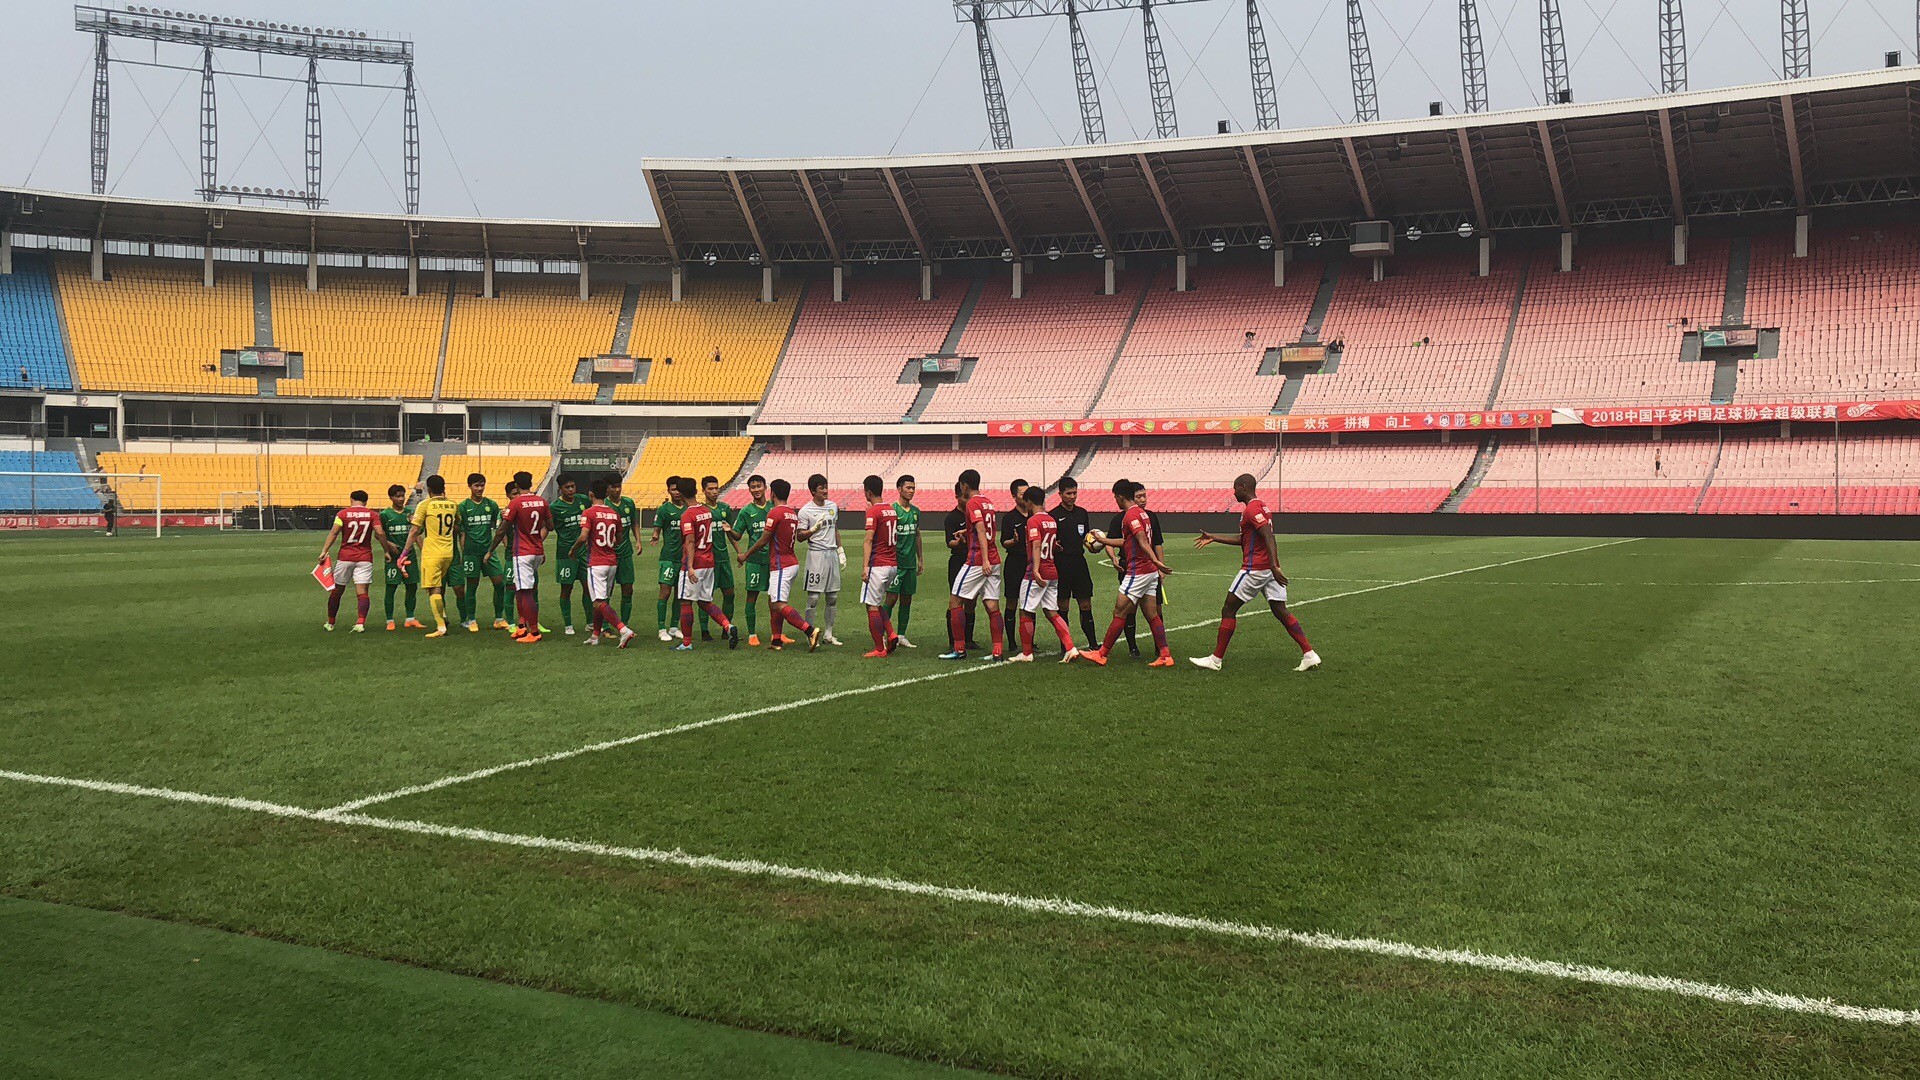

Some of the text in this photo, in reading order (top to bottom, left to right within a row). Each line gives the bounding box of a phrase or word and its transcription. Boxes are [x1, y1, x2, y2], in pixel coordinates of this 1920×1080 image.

[81, 397, 88, 406] 2
[437, 404, 444, 412] 3
[1592, 405, 1838, 423] 2018中国平安中国足球协会超级联赛
[1264, 415, 1411, 430] 团结 欢乐 拼搏 向上
[436, 513, 454, 537] 19
[530, 510, 540, 535] 2
[985, 512, 996, 540] 3
[347, 520, 371, 544] 27
[595, 521, 617, 548] 30
[463, 561, 475, 572] 53
[387, 568, 397, 579] 49
[506, 567, 514, 578] 2
[559, 567, 571, 578] 48
[663, 567, 674, 578] 45
[750, 573, 760, 584] 21
[808, 573, 821, 585] 33
